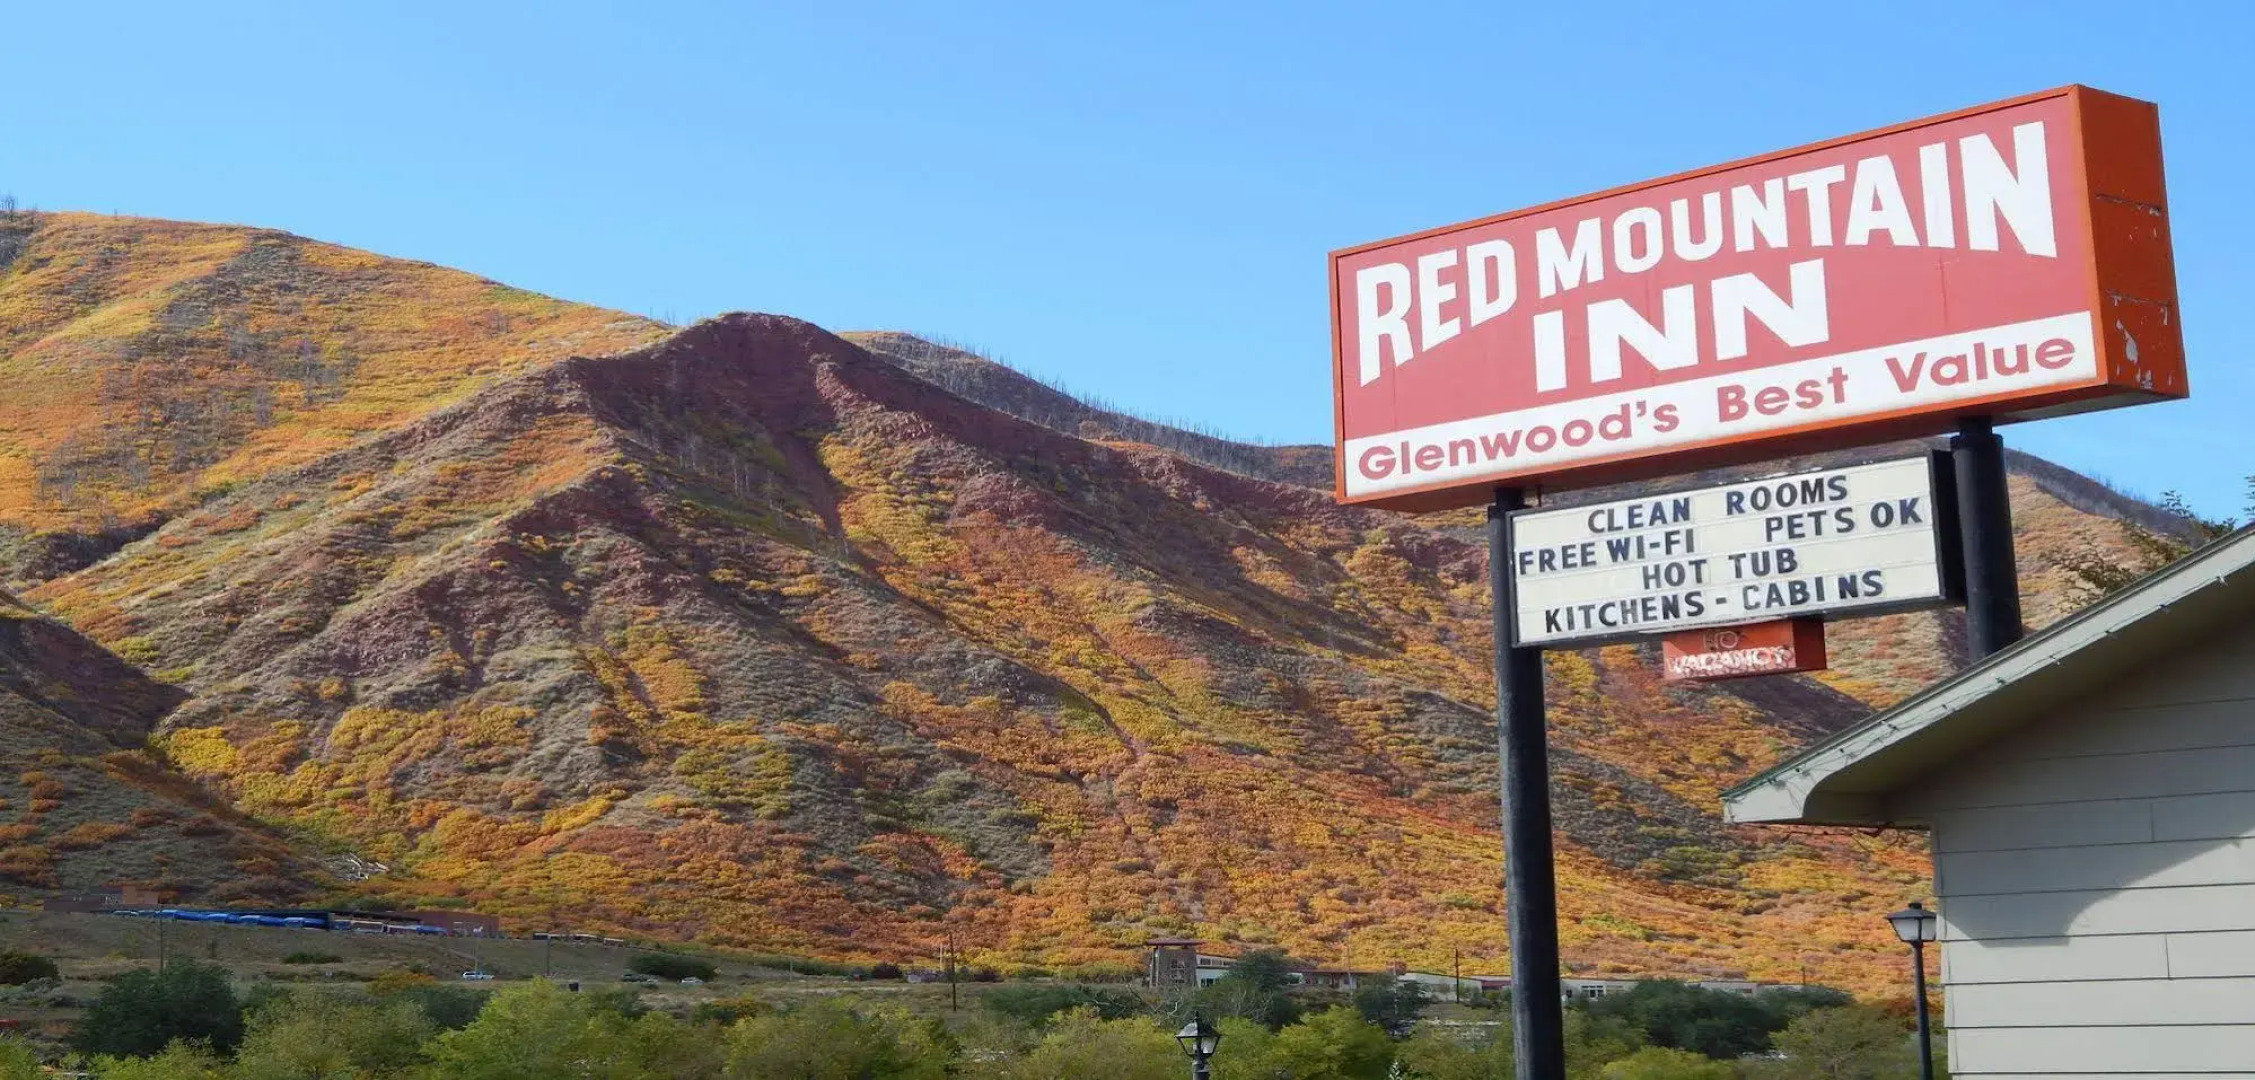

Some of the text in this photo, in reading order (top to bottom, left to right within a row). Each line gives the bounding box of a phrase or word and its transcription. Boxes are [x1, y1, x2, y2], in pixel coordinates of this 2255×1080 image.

[1357, 120, 2057, 387] RED MOUNTAIN
[1533, 258, 1829, 393] INN
[1718, 366, 1849, 423] Best
[1885, 337, 2077, 391] Value
[1519, 497, 1923, 575] FREE WI-FI PETS OK
[1587, 475, 1848, 534] CLEAN ROOMS
[1642, 548, 1798, 590] HOT TUB
[1545, 591, 1704, 633] KITCHENS
